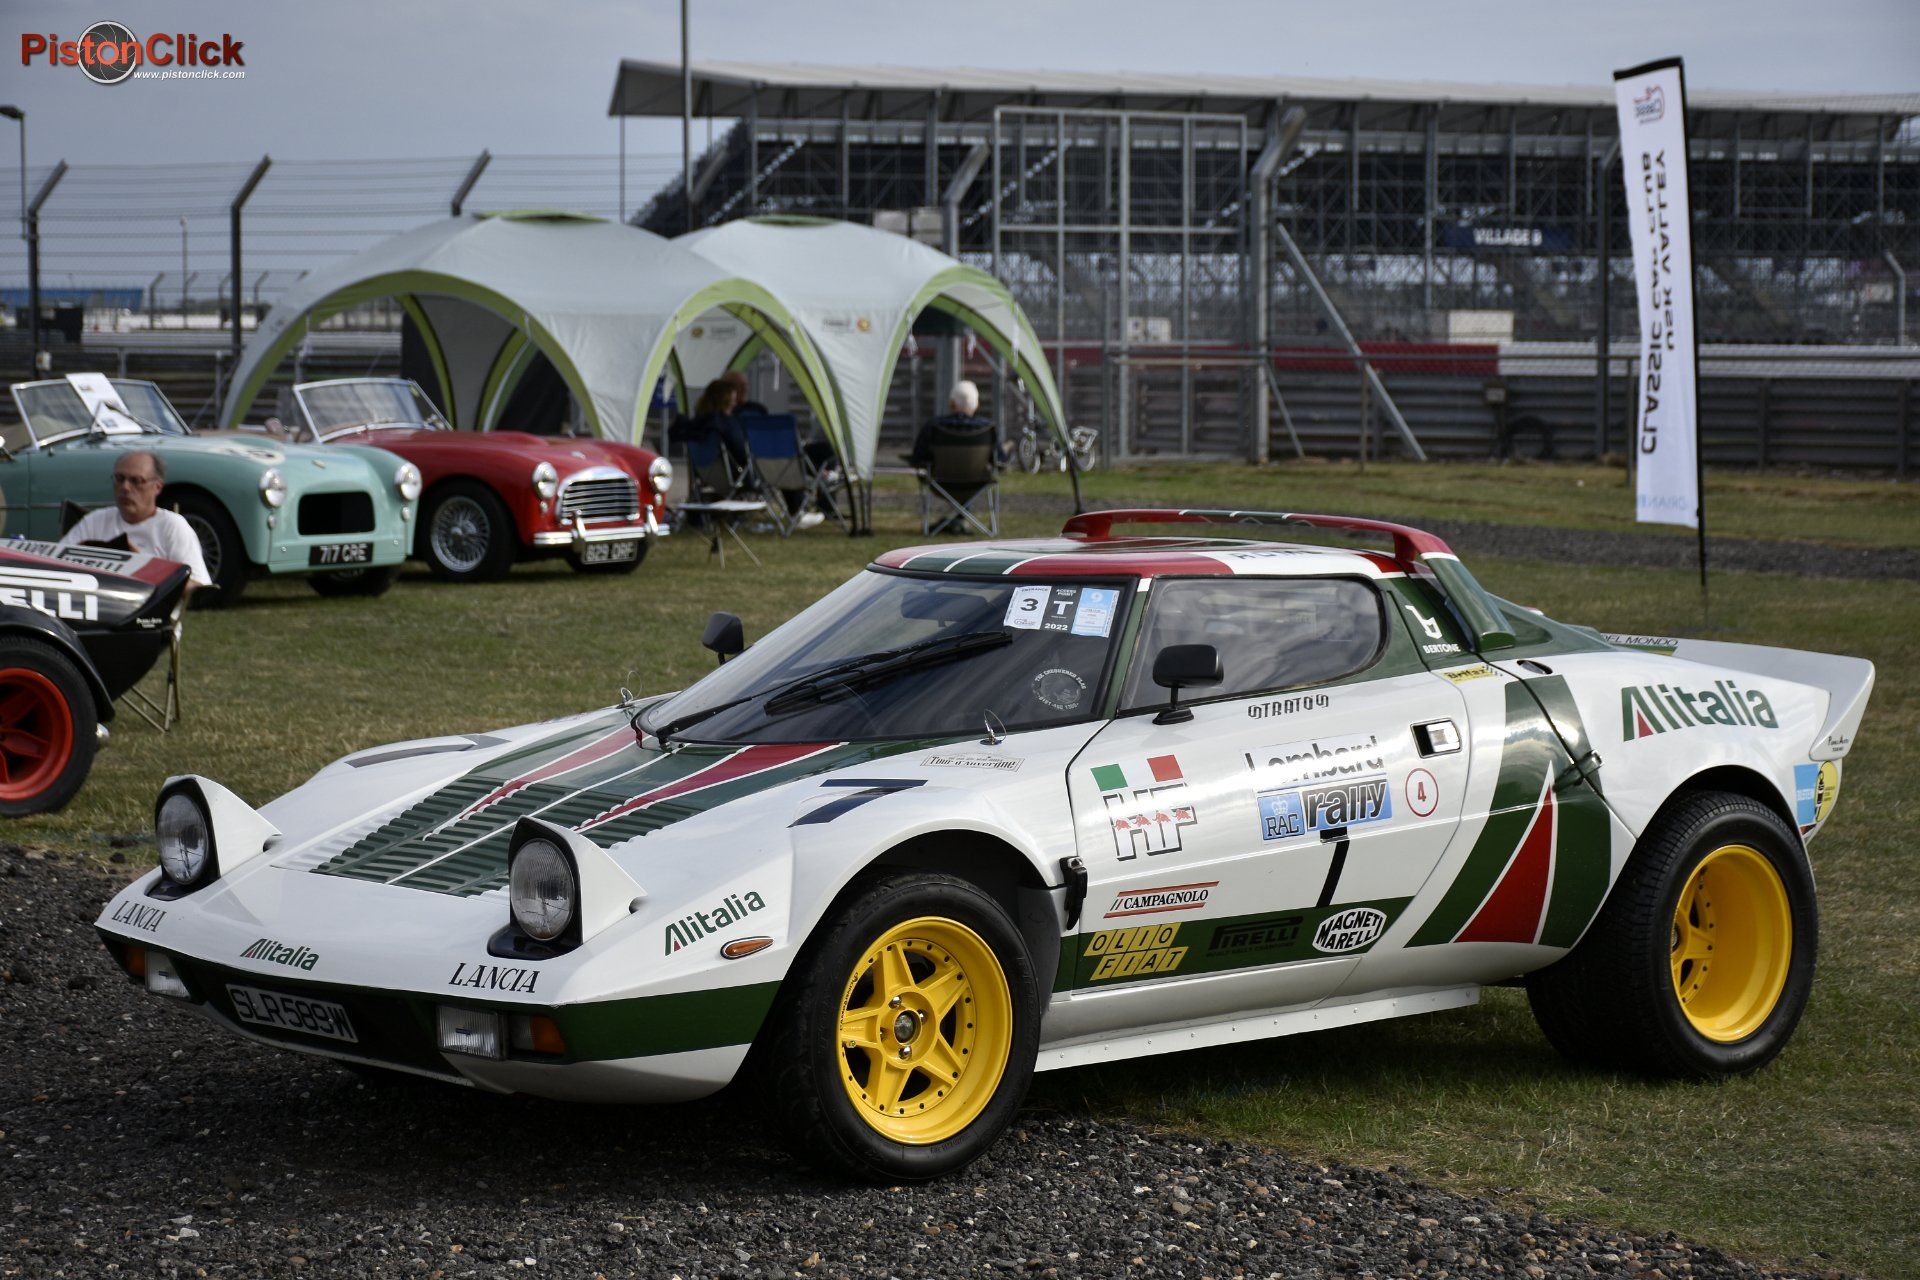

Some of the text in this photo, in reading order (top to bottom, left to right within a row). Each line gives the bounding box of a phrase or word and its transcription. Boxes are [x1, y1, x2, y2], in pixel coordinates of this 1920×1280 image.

[1473, 228, 1530, 246] VILLAGE
[320, 544, 340, 563] 717
[1020, 598, 1039, 612] 3
[1053, 600, 1074, 615] T
[1044, 622, 1068, 631] 2022
[1422, 643, 1461, 654] BERTONE
[1625, 636, 1679, 647] MONDO
[1247, 693, 1331, 720] STRATOS
[1621, 680, 1779, 742] Alitalia
[786, 778, 929, 828] 7
[1417, 781, 1427, 802] 4
[1307, 781, 1388, 830] rally
[1267, 813, 1300, 837] RAC
[1123, 889, 1209, 909] CAMPAGNOLO
[111, 900, 167, 932] LANCIA
[664, 891, 766, 956] Alitalia
[1316, 911, 1383, 940] MAGNETI
[1092, 927, 1173, 951] OLIO
[1209, 915, 1304, 951] PIRELLI
[1316, 925, 1383, 950] MARELLI
[240, 938, 320, 971] Alitalia
[1099, 951, 1182, 975] FIAT
[449, 962, 540, 993] LANCIA
